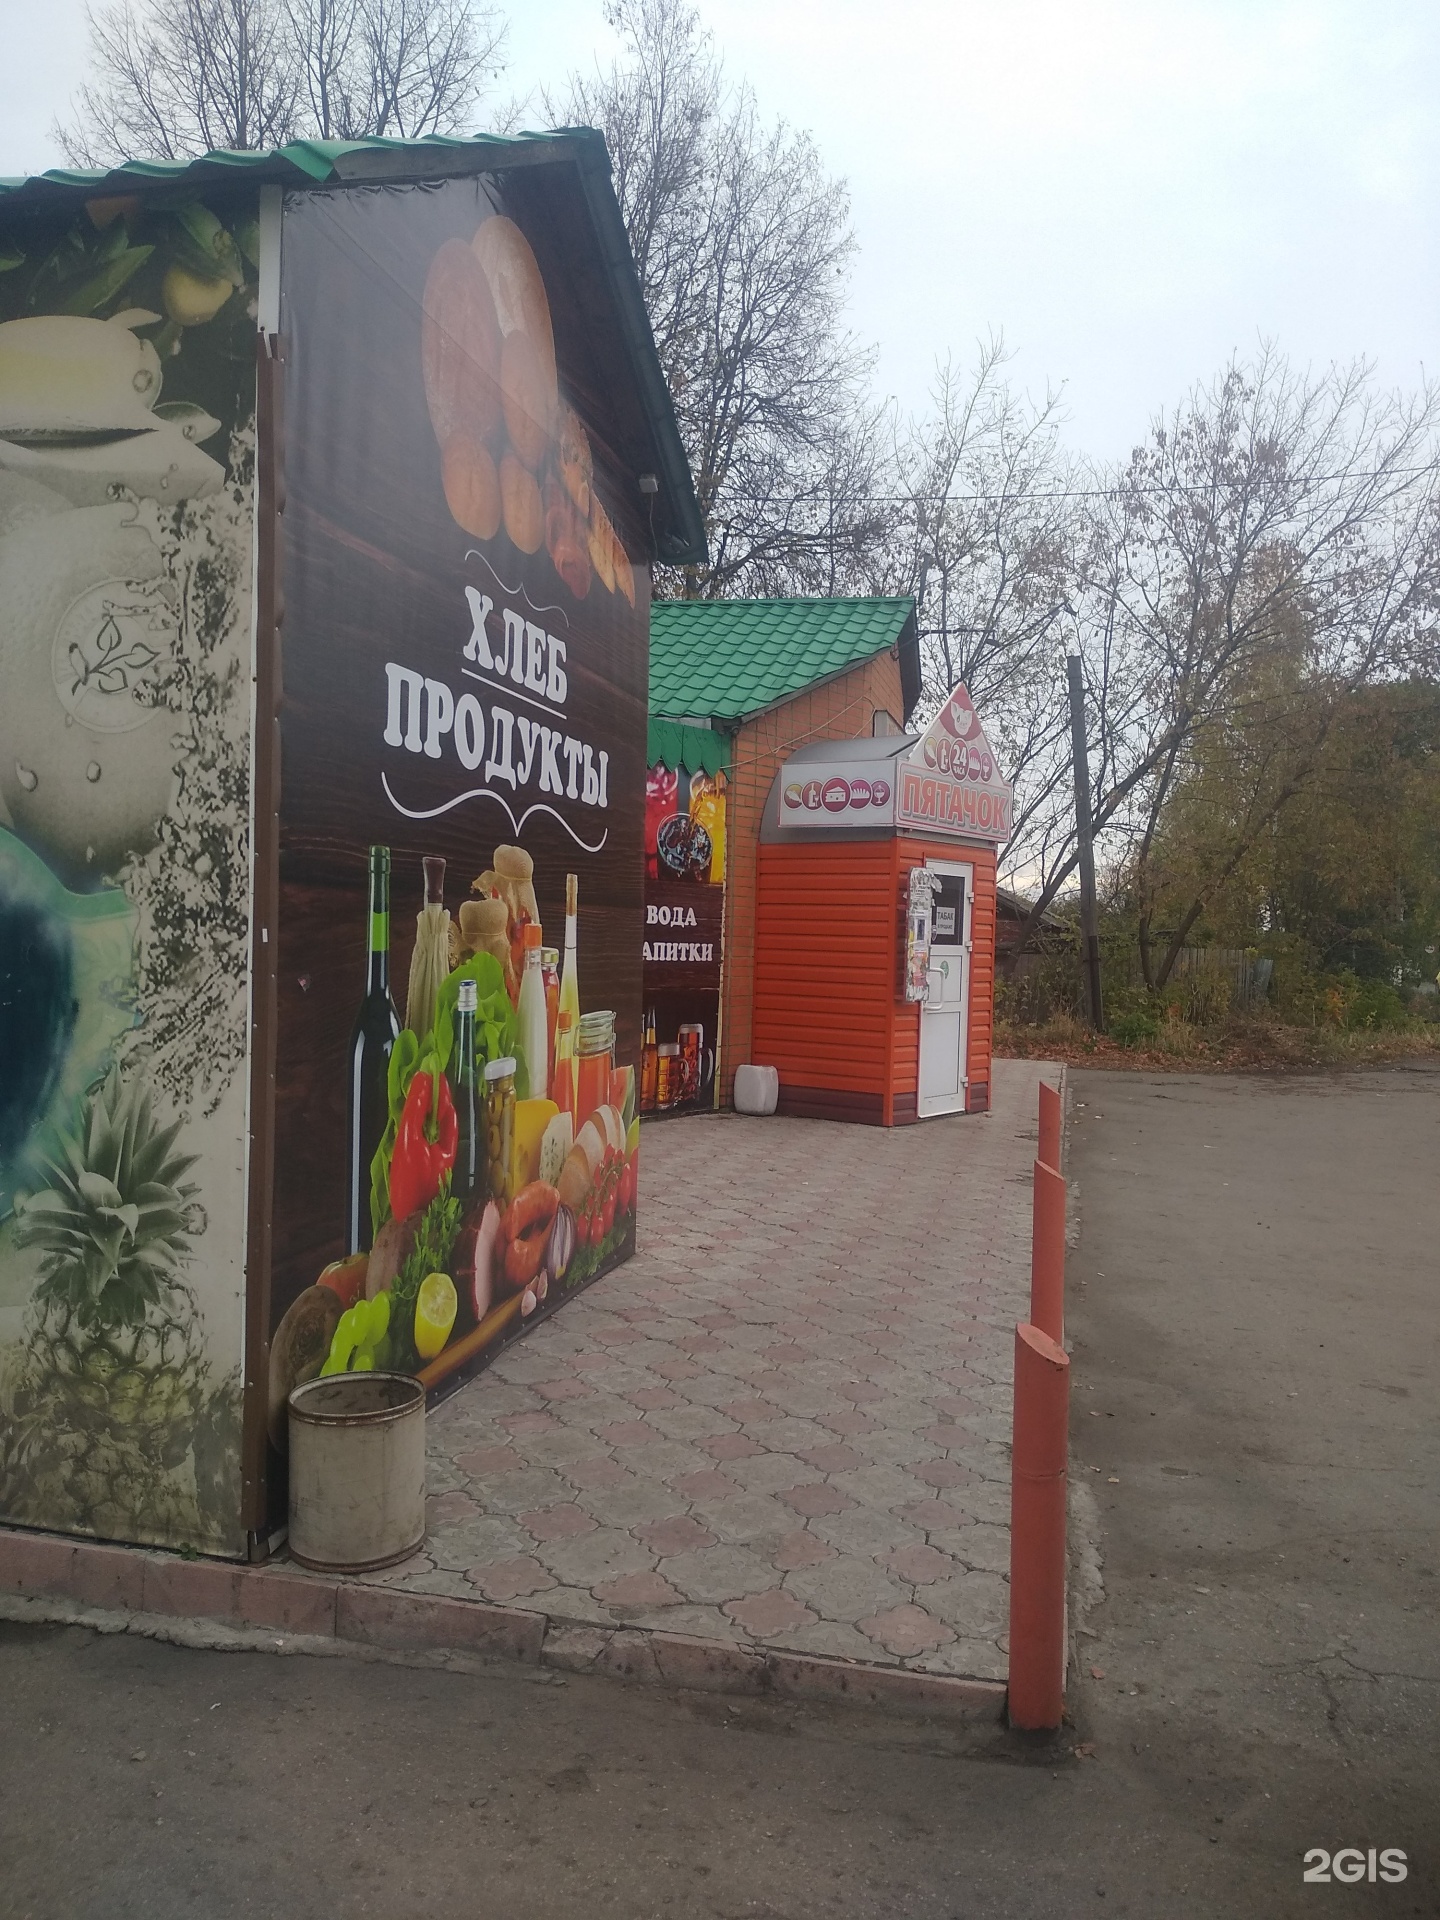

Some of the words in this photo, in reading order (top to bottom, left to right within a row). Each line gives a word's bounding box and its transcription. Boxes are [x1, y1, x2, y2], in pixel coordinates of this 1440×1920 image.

[463, 585, 568, 704] ХЛЕБ
[383, 662, 609, 808] ПРОДУКТЫ
[953, 744, 966, 767] 24
[903, 773, 1008, 832] ПЯТАЧОК
[646, 905, 697, 928] ВОДА
[937, 911, 954, 921] ТАБАК
[642, 941, 714, 962] АПИТКИ
